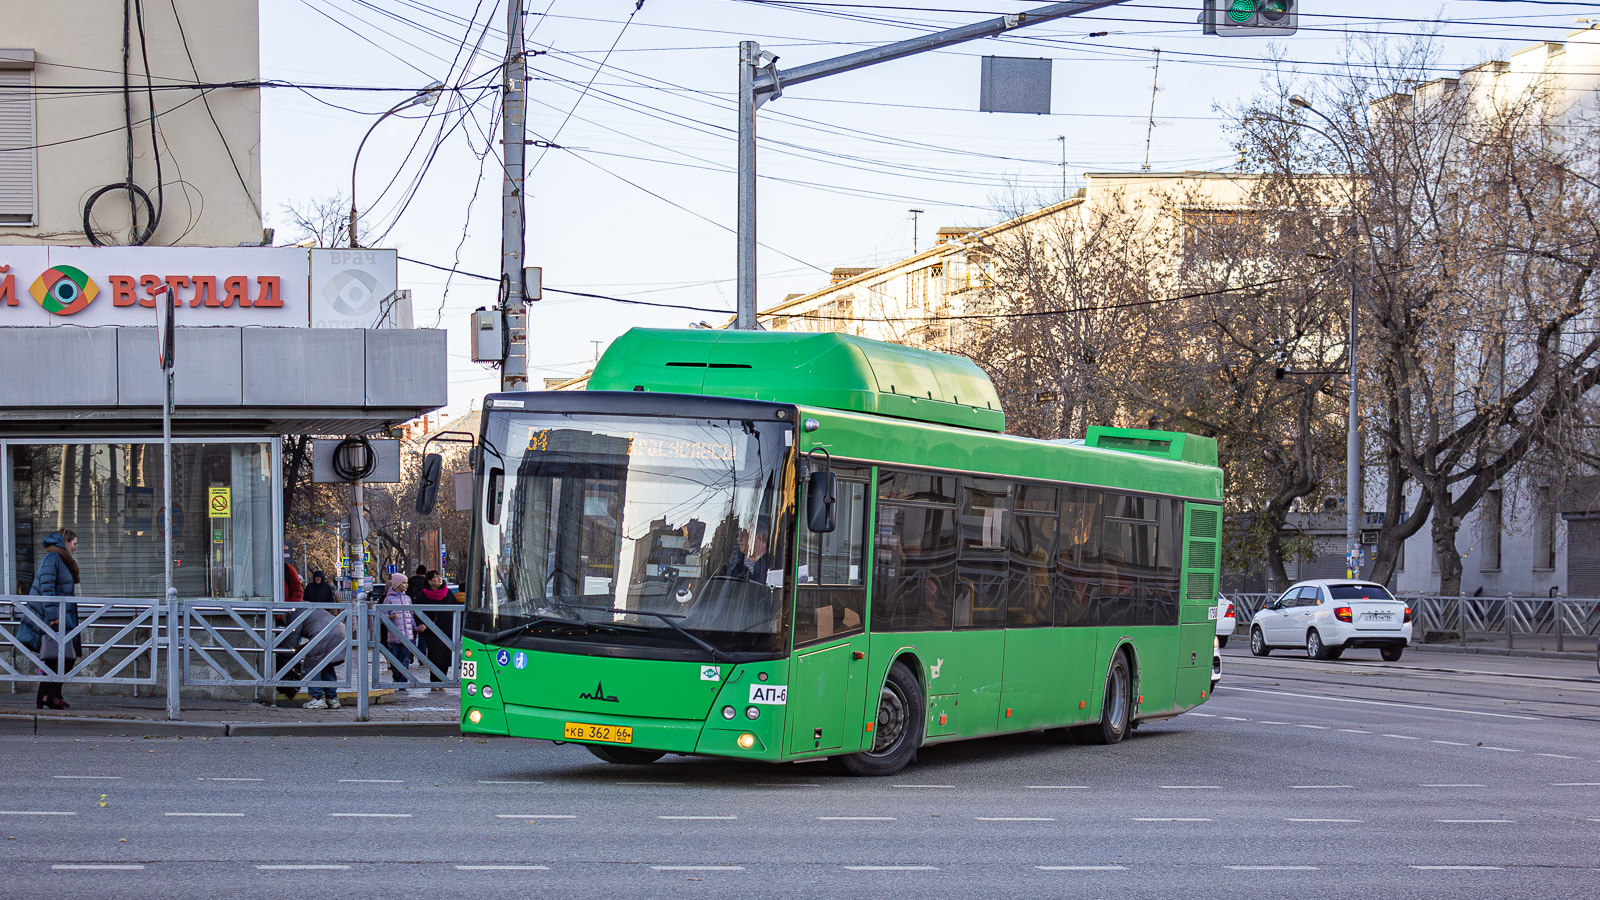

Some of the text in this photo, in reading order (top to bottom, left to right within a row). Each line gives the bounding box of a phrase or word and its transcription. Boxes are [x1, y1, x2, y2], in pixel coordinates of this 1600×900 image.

[108, 274, 284, 307] ВЗГЛЯД
[527, 426, 548, 451] 54
[752, 687, 787, 702] АП-6
[570, 726, 628, 740] КВ 362 66
